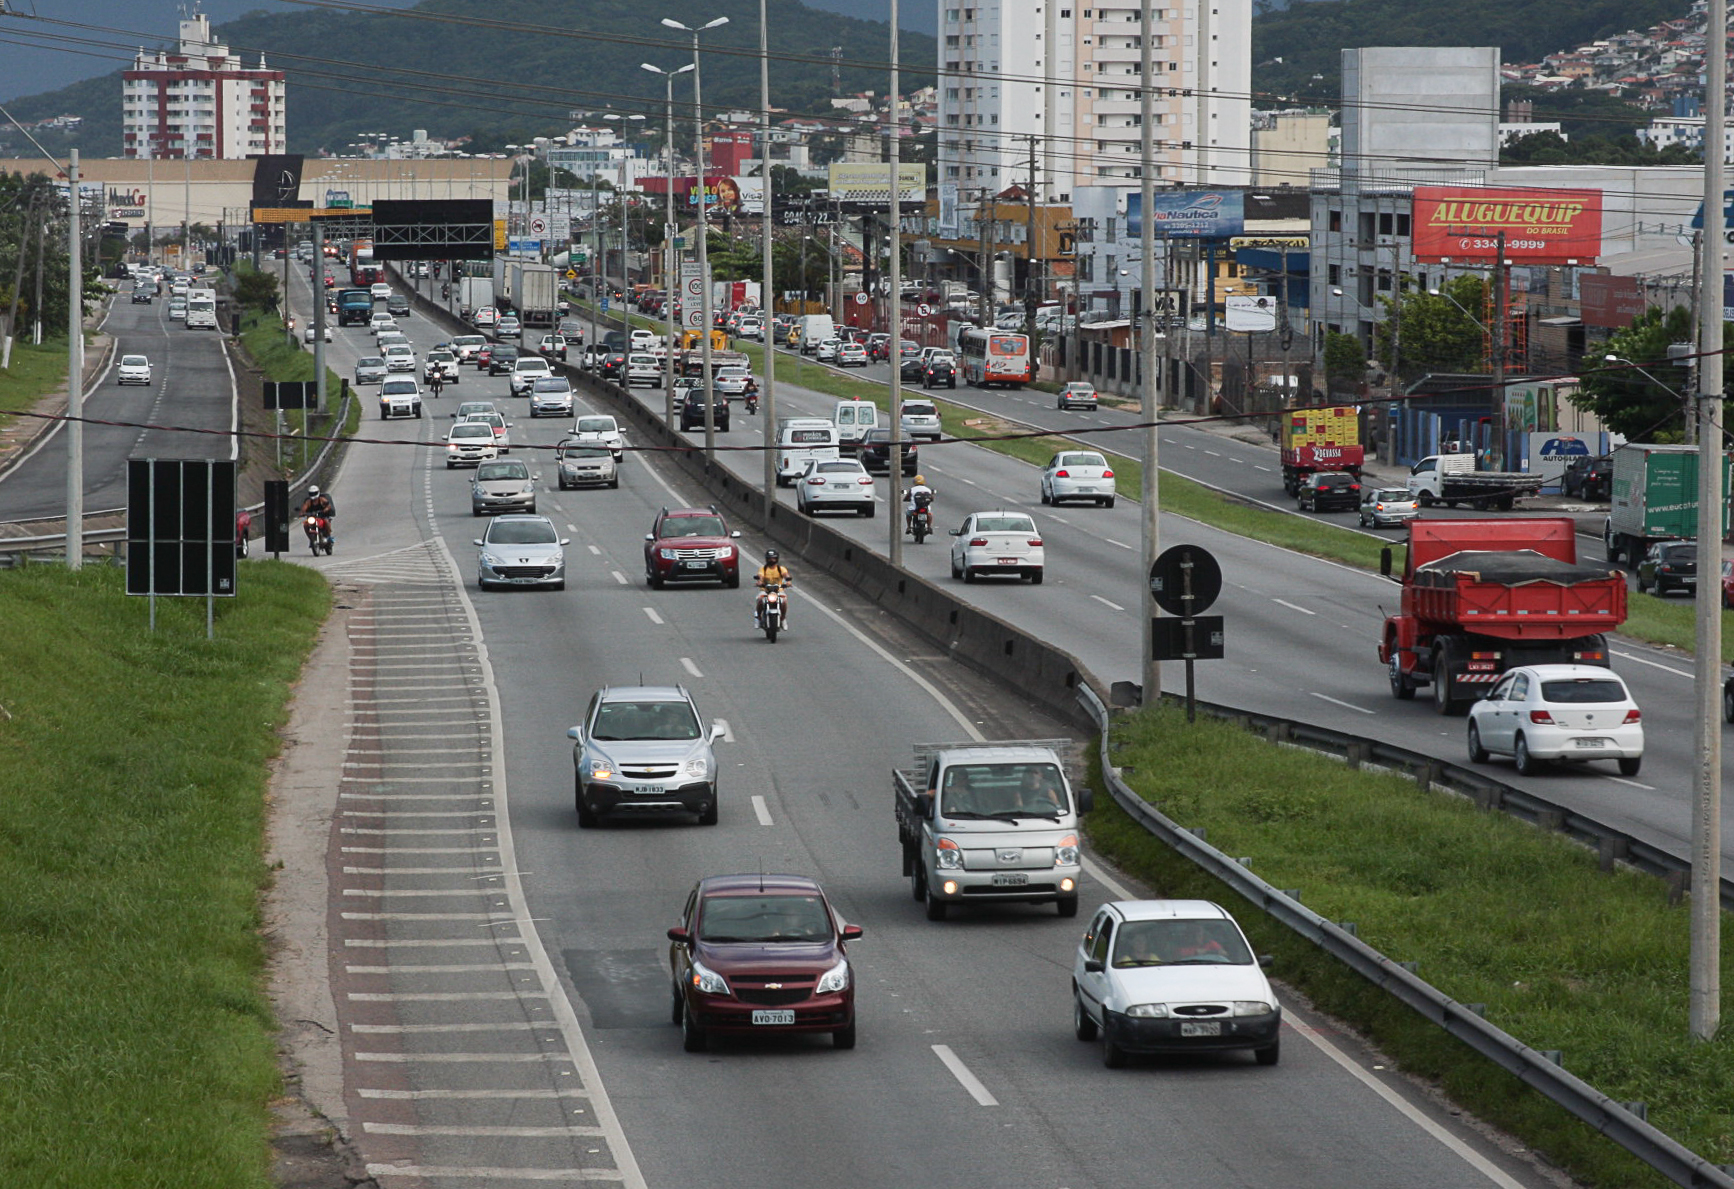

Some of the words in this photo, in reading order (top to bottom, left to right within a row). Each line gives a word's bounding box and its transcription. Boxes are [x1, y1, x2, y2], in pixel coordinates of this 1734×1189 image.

[1430, 202, 1584, 223] ALUGUEQUIP
[1526, 227, 1540, 235] DO
[1541, 227, 1569, 235] BRASIL
[1472, 239, 1546, 249] 334-9999
[1319, 448, 1342, 458] DEVASSA
